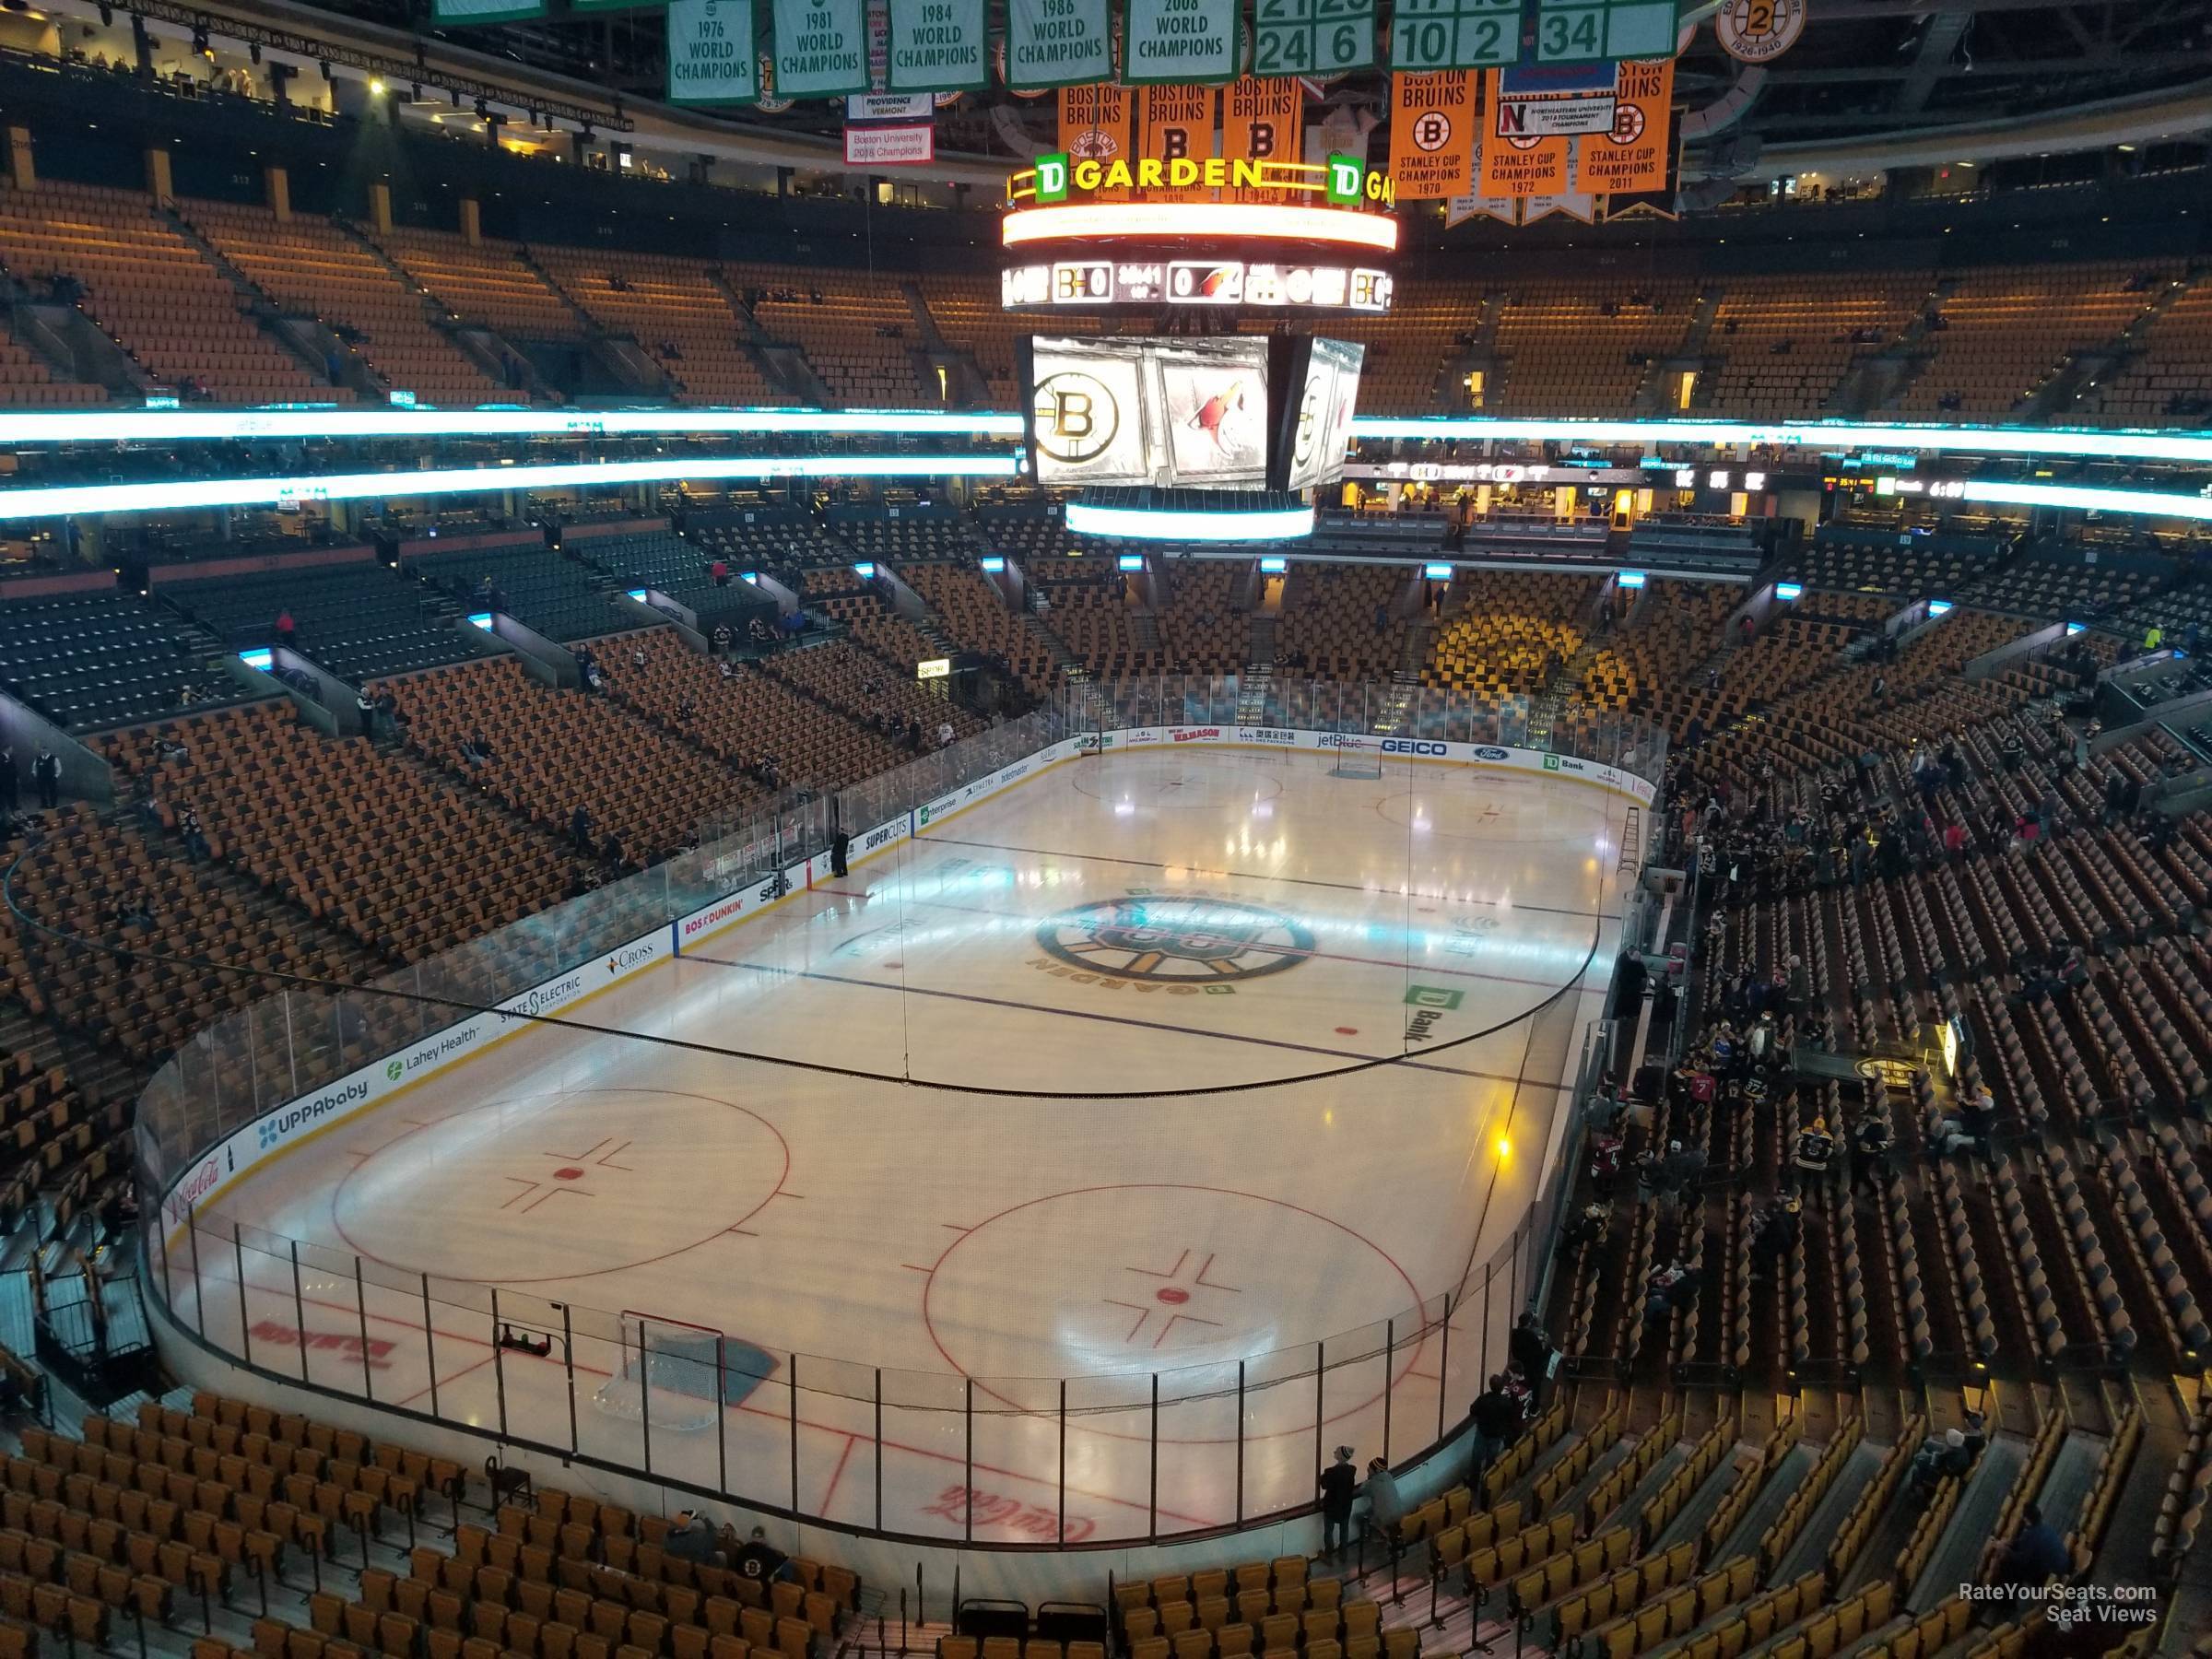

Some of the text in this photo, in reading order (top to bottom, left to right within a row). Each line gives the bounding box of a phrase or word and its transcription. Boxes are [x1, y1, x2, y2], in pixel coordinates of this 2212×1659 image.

[923, 5, 952, 23] 1984
[1042, 0, 1074, 18] 1986
[1751, 6, 1770, 29] 2
[698, 21, 724, 38] 1976
[806, 12, 831, 29] 1981
[1034, 18, 1085, 41] WORLD
[1157, 17, 1208, 34] WORLD
[796, 33, 842, 53] WORLD
[912, 27, 962, 45] WORLD
[1400, 22, 1448, 62] 10
[1474, 20, 1501, 60] 2
[1543, 12, 1597, 57] 34
[689, 42, 733, 59] WORLD
[1018, 39, 1102, 63] CHAMPIONS
[1139, 38, 1223, 58] CHAMPIONS
[1258, 29, 1307, 69] 24
[1333, 26, 1357, 64] 6
[782, 53, 858, 74] CHAMPIONS
[897, 47, 978, 67] CHAMPIONS
[675, 62, 747, 79] CHAMPIONS
[1067, 87, 1122, 104] BOSTON
[1150, 85, 1205, 102] BOSTON
[1234, 78, 1291, 96] BOSTON
[1403, 86, 1465, 107] BRUINS
[1618, 76, 1660, 99] UINS
[866, 97, 912, 105] PROVIDENCE
[872, 106, 906, 115] VERMONT
[1233, 96, 1291, 117] BRUINS
[1578, 104, 1612, 112] UNIVERSITY
[1067, 105, 1121, 124] BRUINS
[1150, 102, 1204, 122] BRUINS
[1501, 104, 1526, 133] N
[1423, 121, 1441, 143] B
[1618, 114, 1633, 135] B
[853, 133, 923, 144] Boston University
[1070, 131, 1118, 154] BOSTON
[1161, 127, 1189, 160] B
[1249, 122, 1276, 159] B
[877, 147, 923, 158] Champions
[1401, 155, 1461, 168] STANLEY CUP
[1494, 153, 1555, 167] STANLEY CUP
[1591, 147, 1655, 162] STANLEY CUP
[1039, 162, 1065, 194] TD
[1076, 159, 1263, 190] GARDEN
[1399, 169, 1461, 182] CHAMPIONS
[1492, 166, 1556, 181] CHAMPIONS
[1589, 162, 1654, 176] CHAMPIONS
[1333, 163, 1359, 196] TD
[1418, 182, 1441, 194] 1970
[1512, 182, 1535, 193] 1972
[1610, 178, 1632, 189] 2011
[1090, 268, 1106, 296] 0
[1175, 268, 1193, 296] 0
[1054, 391, 1093, 438] B
[1317, 734, 1361, 748] jetBlue
[1382, 740, 1447, 756] GEICO
[1479, 747, 1503, 759] Ford
[1562, 759, 1583, 771] Bank
[865, 821, 908, 850] SUPERCUTS
[686, 898, 743, 935] BOS DUNKIN'
[501, 1002, 528, 1023] STATE
[540, 977, 581, 1004] ELECTRIC
[1403, 1010, 1443, 1041] Bank
[406, 1027, 477, 1070] Lahey Health
[278, 1081, 368, 1134] UPPAbaby
